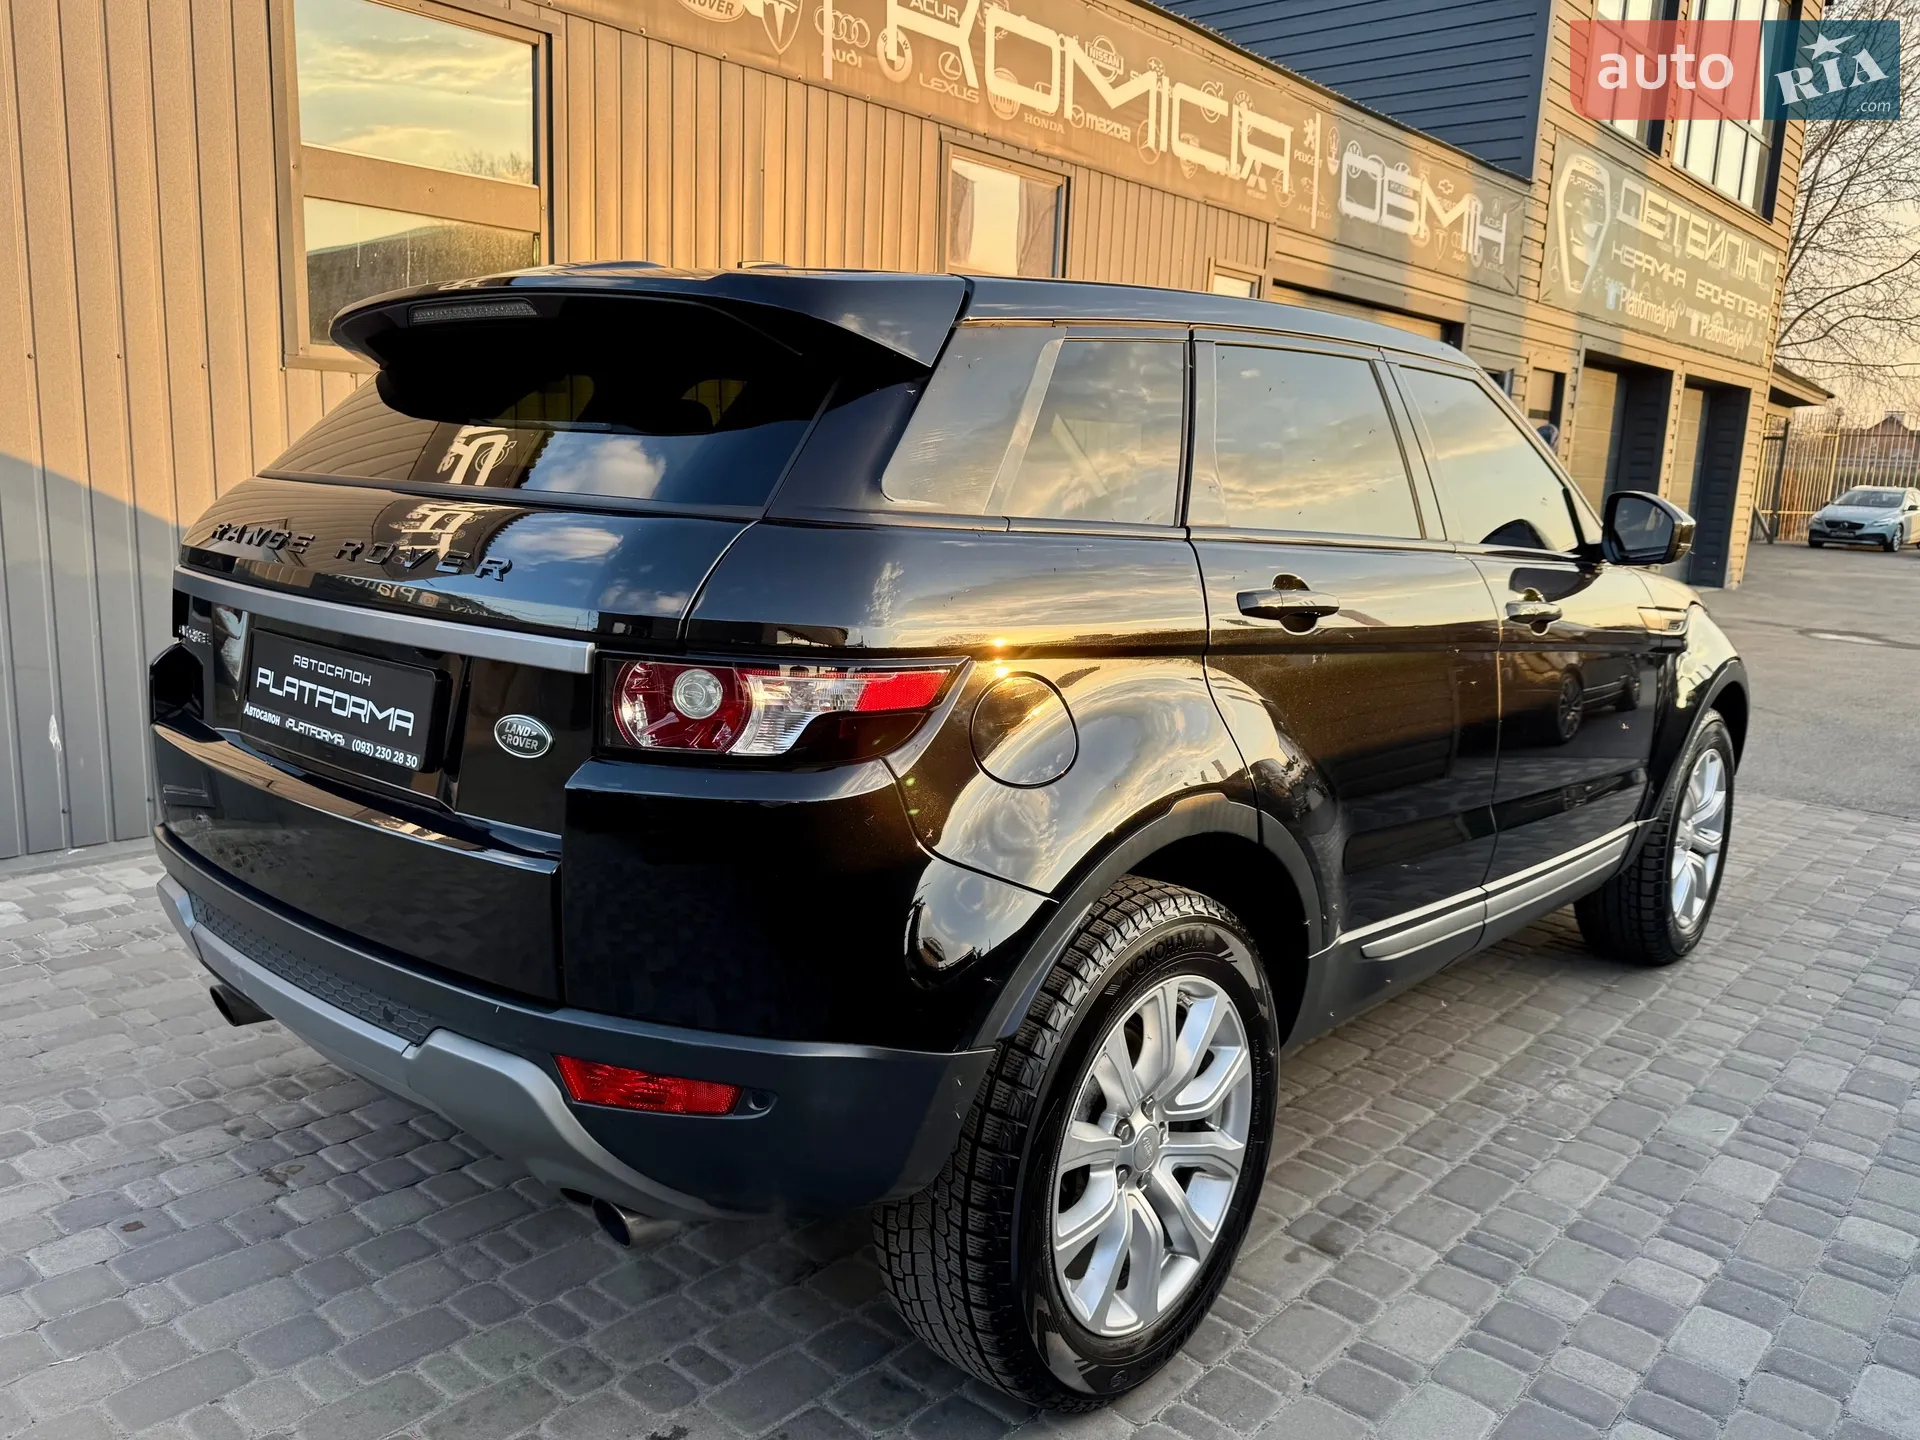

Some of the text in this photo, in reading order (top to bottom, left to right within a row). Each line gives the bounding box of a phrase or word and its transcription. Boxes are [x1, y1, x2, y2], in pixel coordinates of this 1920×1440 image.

[909, 0, 960, 24] ACUR
[1089, 46, 1121, 68] NISSAN
[919, 72, 980, 104] LEXUS
[1023, 112, 1065, 135] HONDA
[211, 523, 513, 582] RANGE ROVER
[292, 654, 372, 686] АВТОСАЛОН
[256, 666, 415, 737] PLATFORMA
[243, 702, 281, 726] Автосалон
[352, 738, 374, 757] (093)
[375, 746, 391, 761] 230
[393, 751, 404, 764] 28
[406, 755, 418, 769] 30
[504, 721, 531, 737] LAND
[506, 733, 539, 751] ROVER
